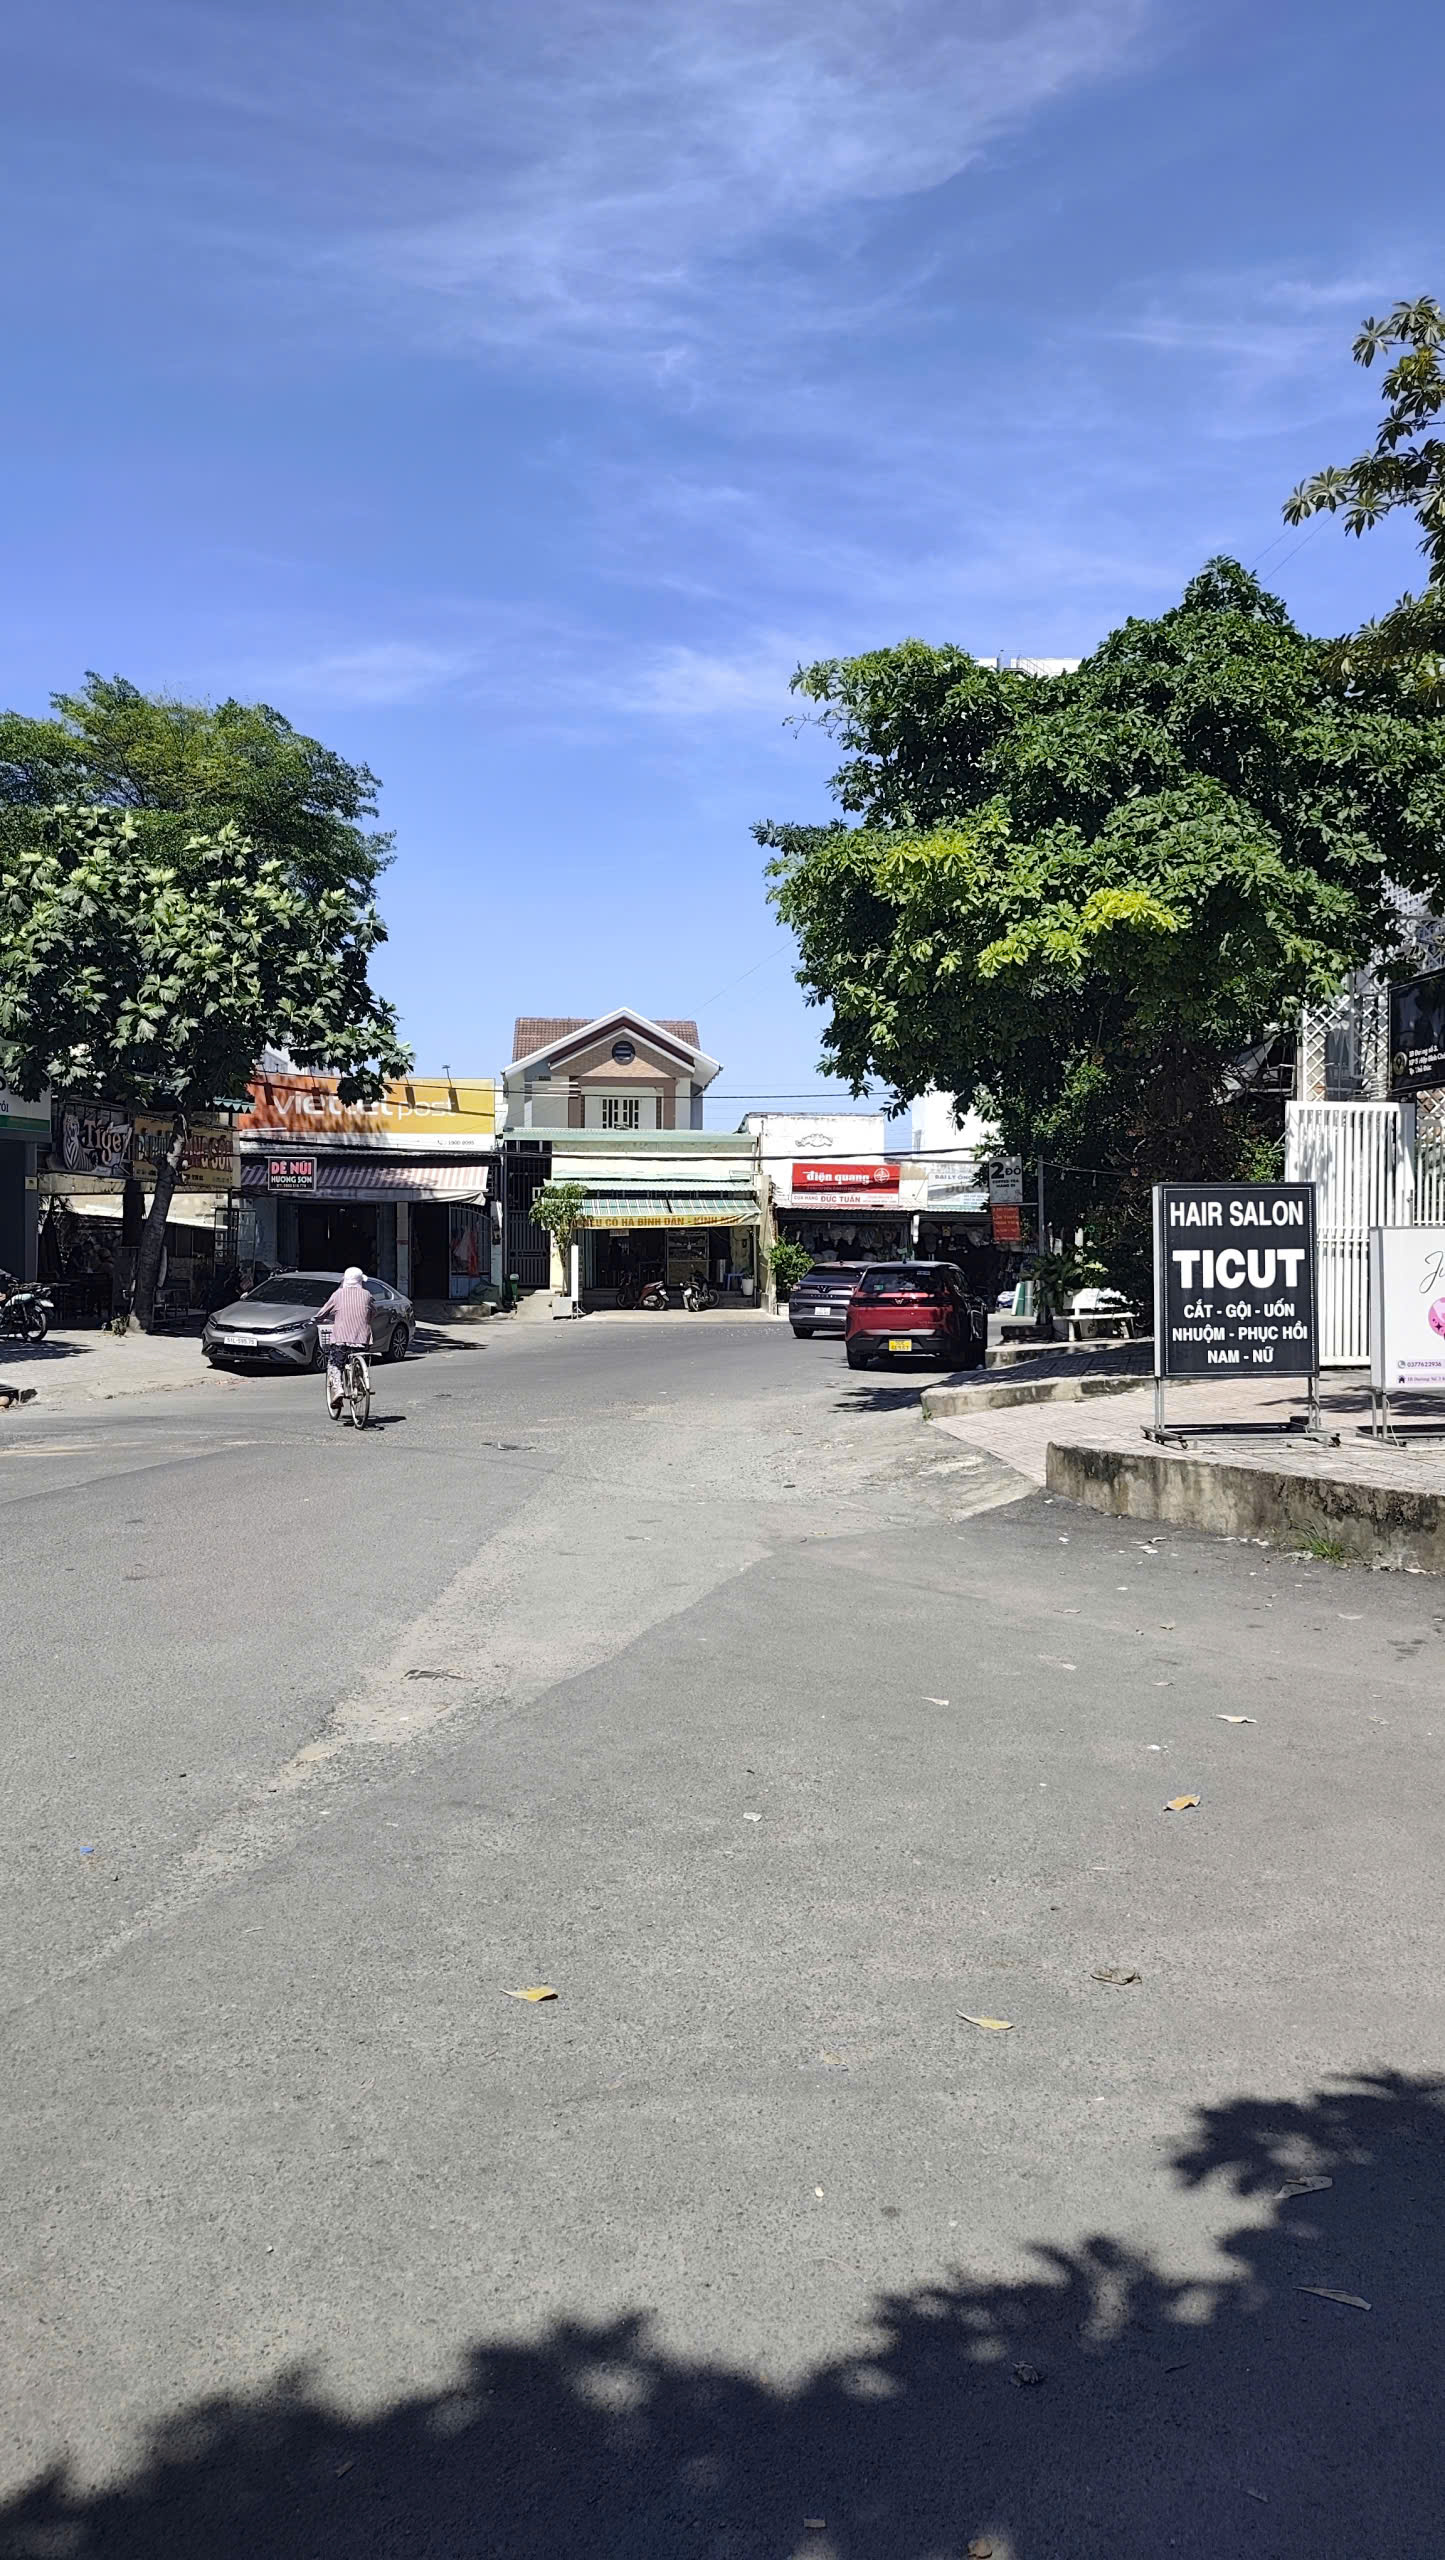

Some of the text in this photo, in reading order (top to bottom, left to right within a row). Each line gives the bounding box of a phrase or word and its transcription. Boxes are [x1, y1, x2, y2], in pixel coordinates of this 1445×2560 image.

[398, 1095, 457, 1120] post
[81, 1118, 132, 1165] Tiger
[990, 1161, 1005, 1179] 2
[1170, 1200, 1304, 1227] HAIR SALON
[1172, 1248, 1305, 1289] TICUT
[1183, 1299, 1213, 1319] CẮT
[1225, 1301, 1252, 1320] GỘI
[1264, 1298, 1295, 1318] UỐN
[1172, 1324, 1225, 1344] NHUỘM
[1238, 1326, 1279, 1343] PHỤC
[1282, 1320, 1308, 1340] HỒI
[1207, 1350, 1240, 1364] NAM
[1252, 1346, 1274, 1364] NỮ
